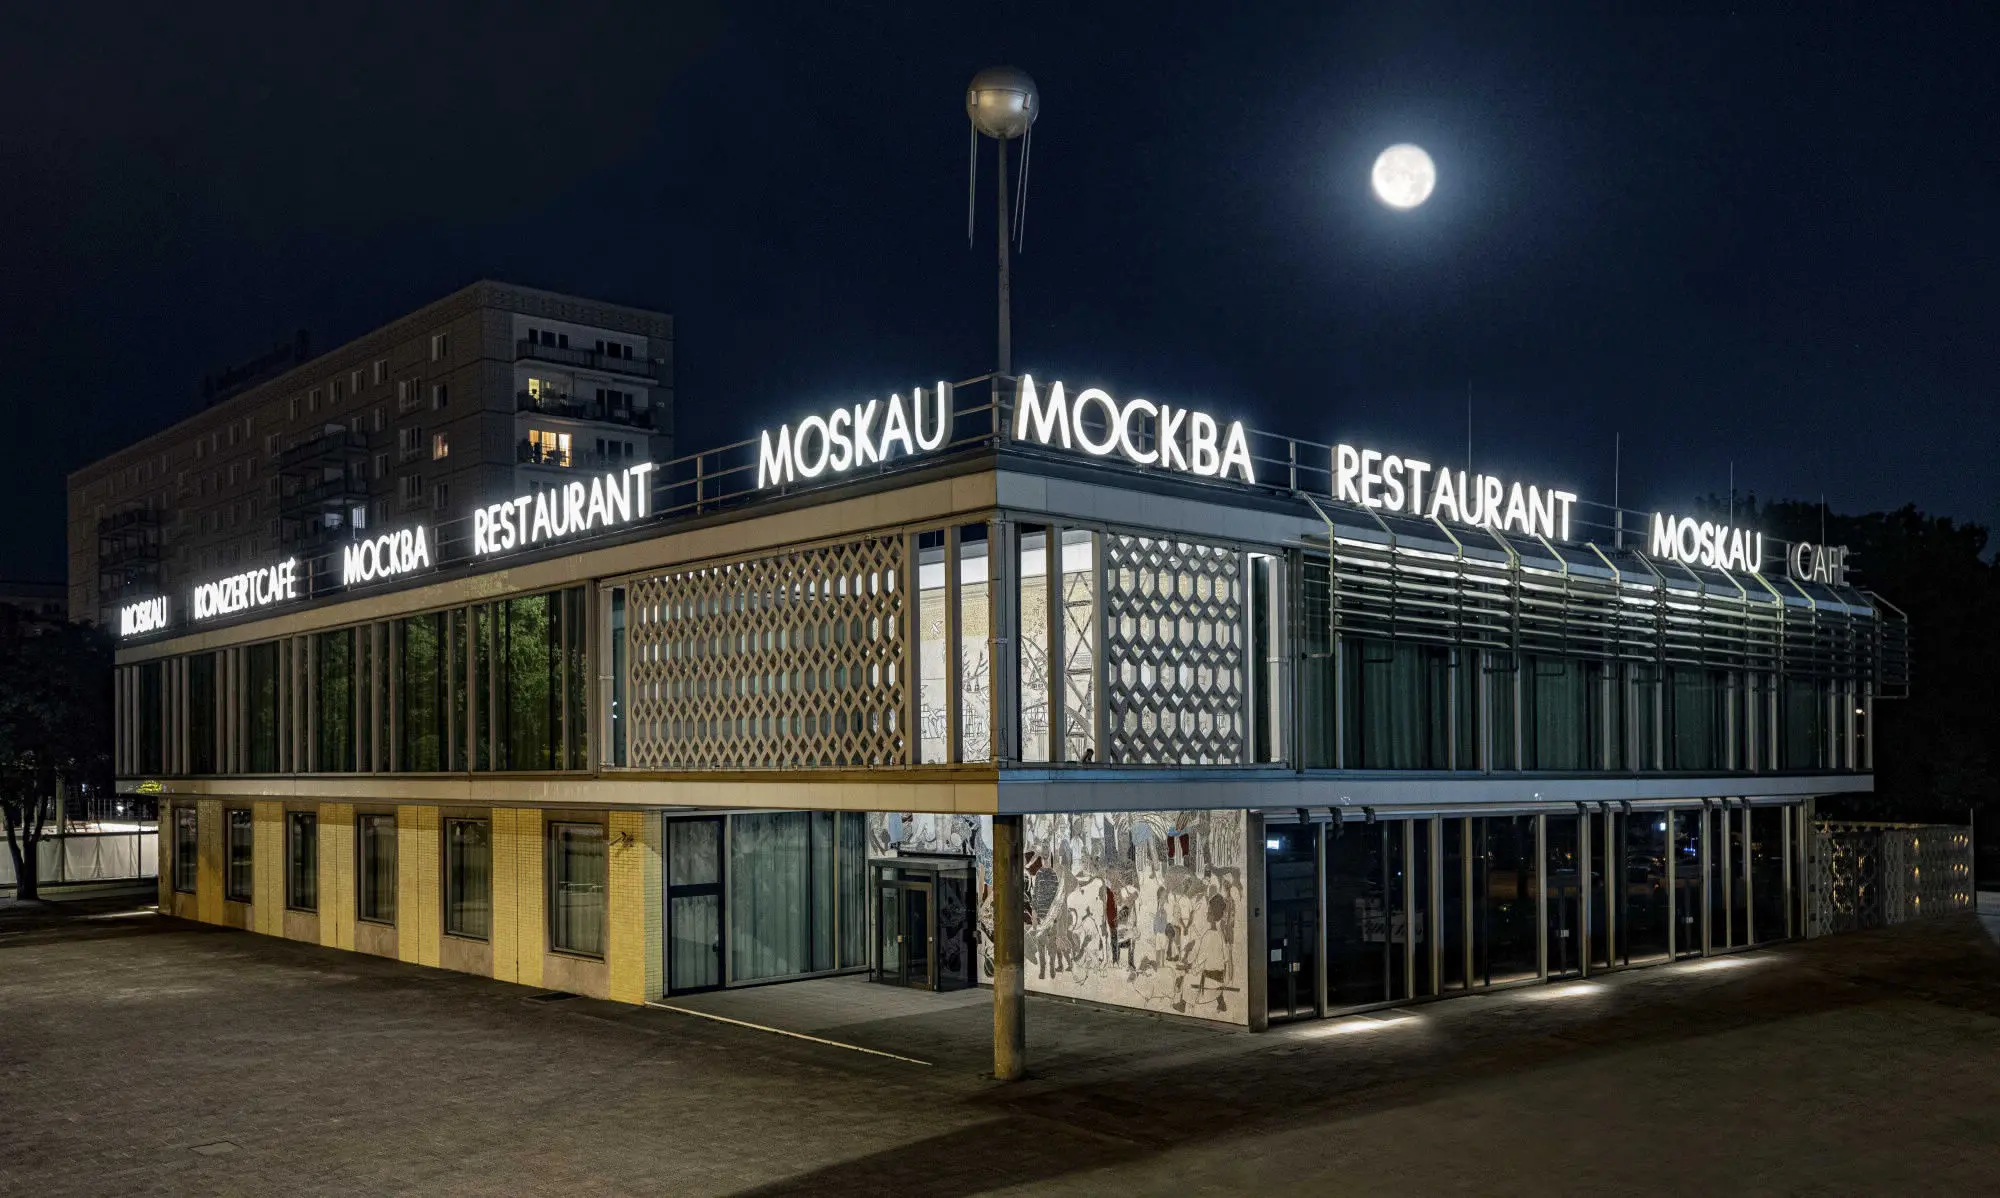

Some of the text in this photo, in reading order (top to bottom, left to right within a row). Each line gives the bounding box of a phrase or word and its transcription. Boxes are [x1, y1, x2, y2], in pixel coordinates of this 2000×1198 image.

[758, 381, 948, 489] MOSKAU
[1017, 374, 1256, 485] МОСКВА
[474, 462, 653, 556] RESTAURANT
[1334, 444, 1578, 542] RESTAURANT
[343, 525, 430, 585] МОСКВА
[1652, 512, 1762, 574] MOSKAU
[121, 596, 167, 637] MOSKAU
